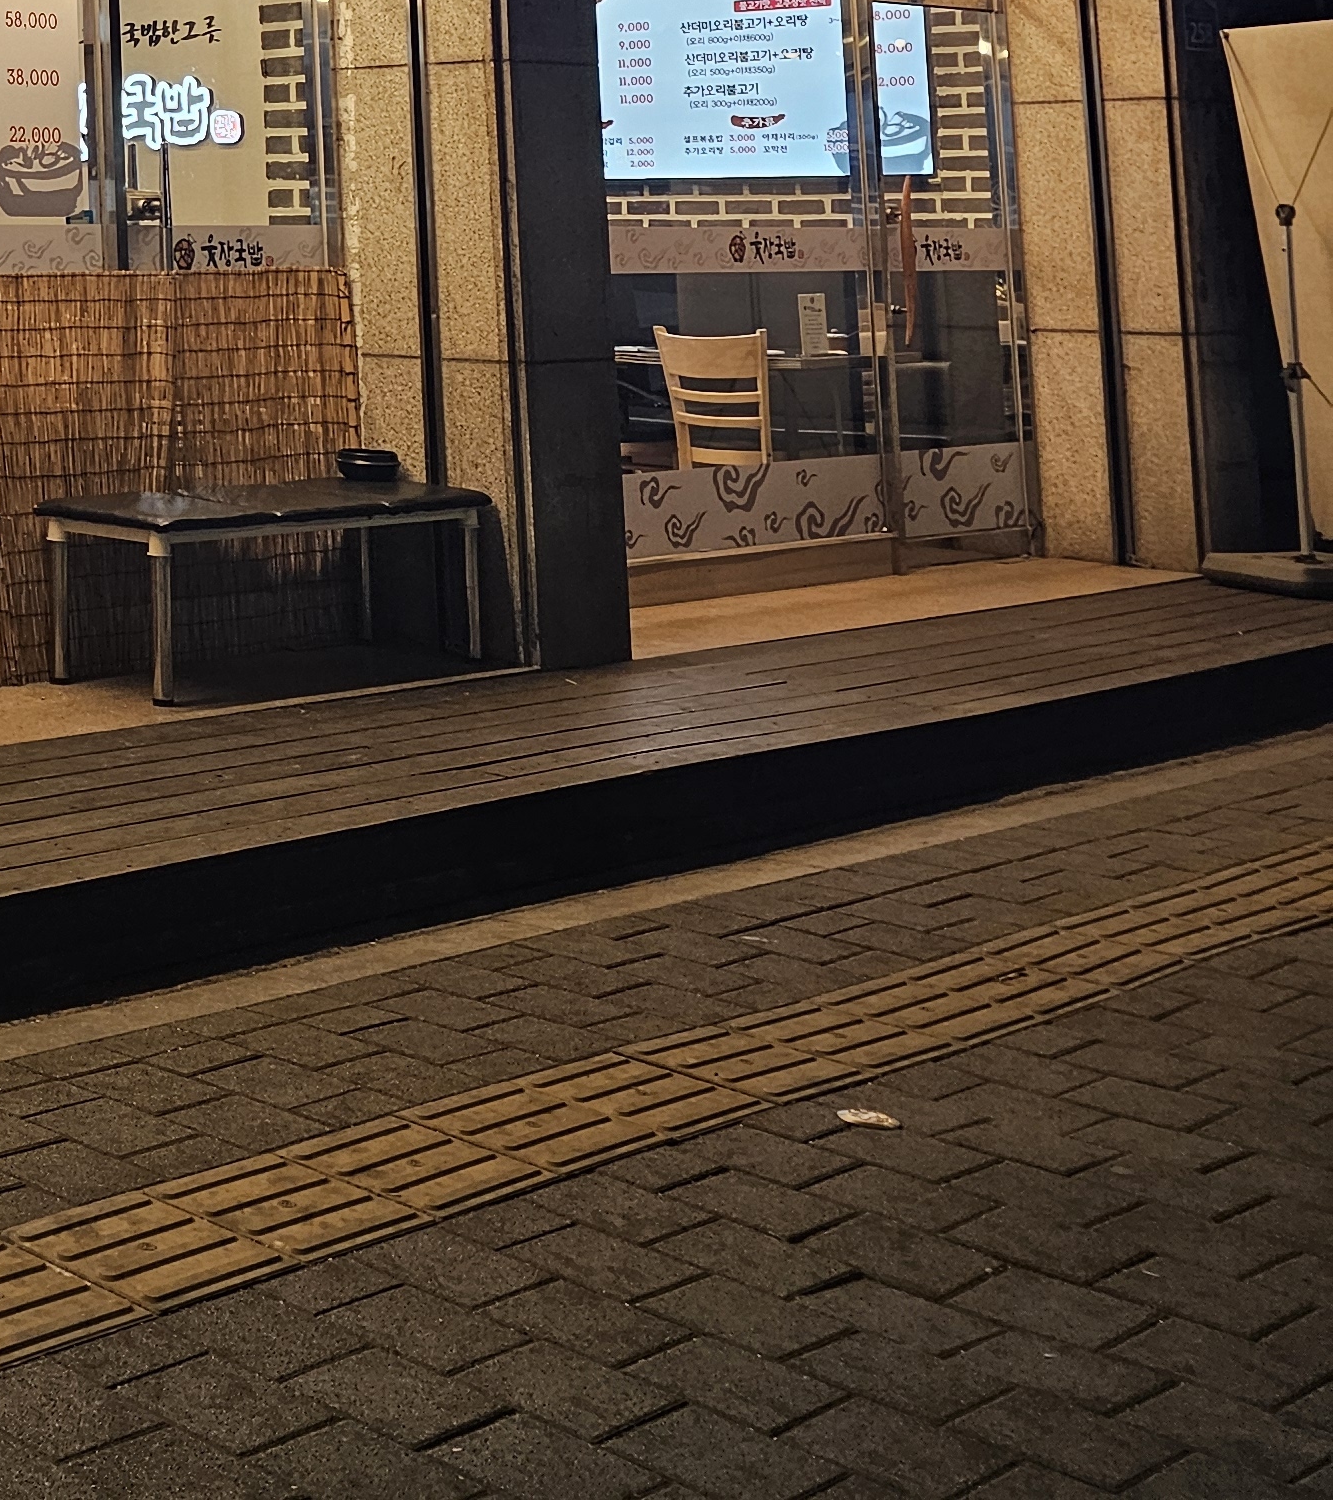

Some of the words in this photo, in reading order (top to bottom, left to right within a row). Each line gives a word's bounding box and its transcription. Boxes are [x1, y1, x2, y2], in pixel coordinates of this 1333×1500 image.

[4, 10, 58, 31] 58,000
[873, 8, 911, 21] 8,000
[875, 42, 913, 54] 8,000
[6, 67, 60, 88] 38,000
[877, 75, 915, 88] 2,000
[9, 125, 62, 145] 22,000
[199, 233, 264, 268] 웃장국밥
